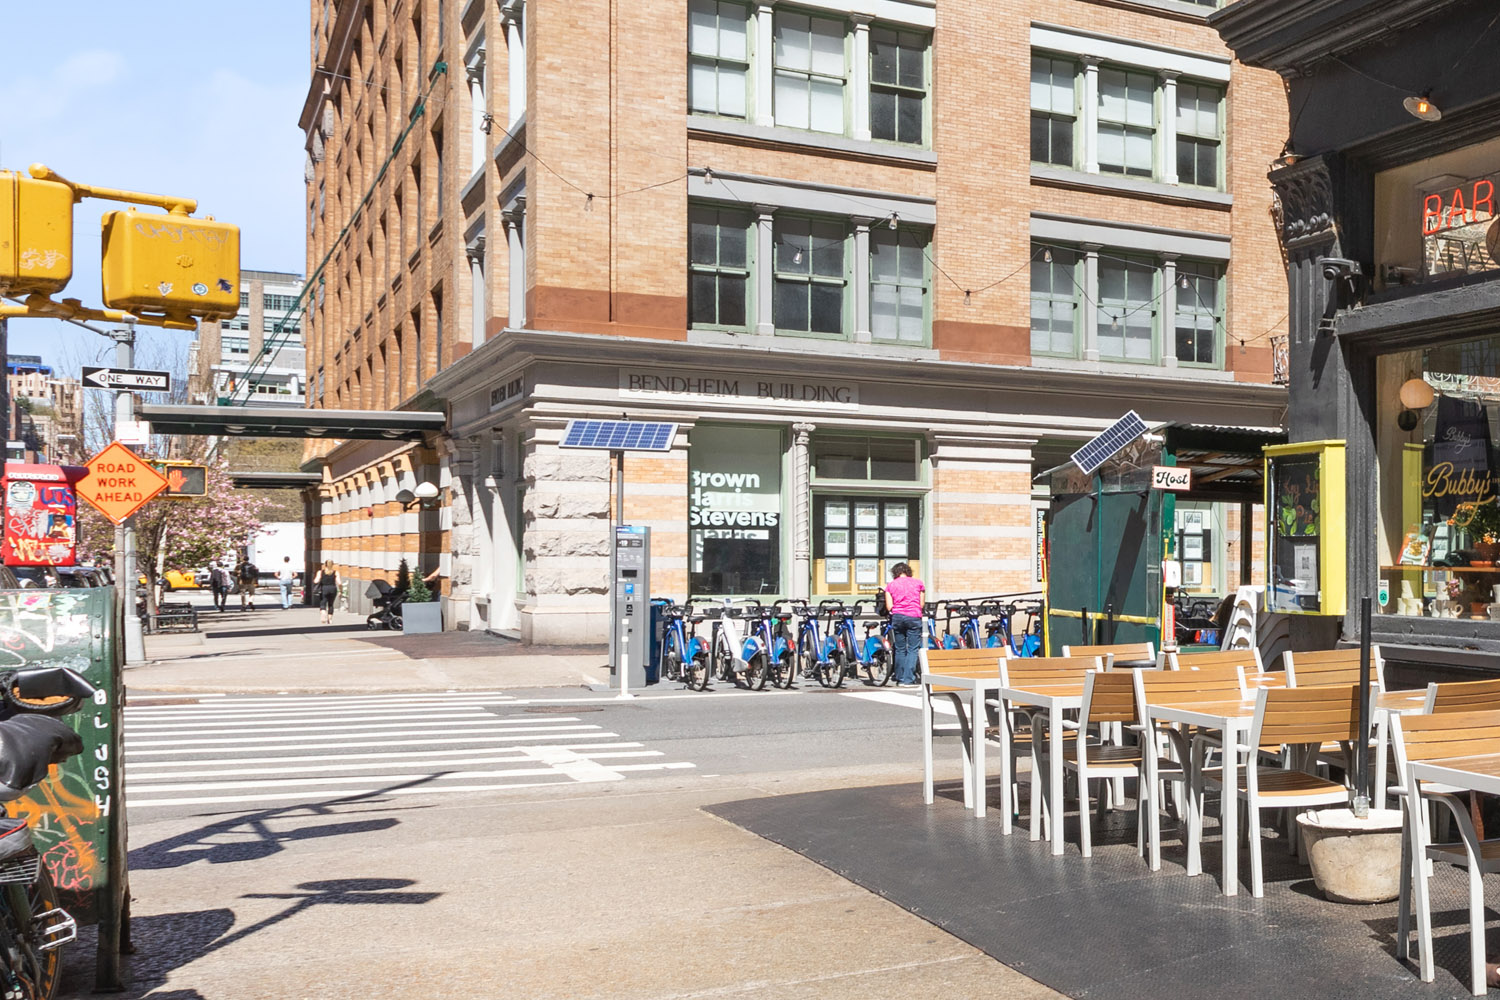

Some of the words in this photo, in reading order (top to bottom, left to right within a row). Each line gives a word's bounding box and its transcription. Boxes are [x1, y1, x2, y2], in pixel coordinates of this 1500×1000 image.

[1424, 180, 1494, 235] BAR
[99, 373, 123, 383] ONE
[136, 376, 161, 386] WAY
[628, 374, 740, 398] BENDHEIM
[756, 382, 851, 404] BUILDING
[97, 463, 136, 473] ROAD
[97, 478, 136, 488] WORK
[691, 470, 760, 489] Brown
[1156, 471, 1189, 487] Host
[95, 492, 143, 502] AHEAD
[1423, 461, 1497, 526] Bubby's
[690, 506, 778, 527] Stevens
